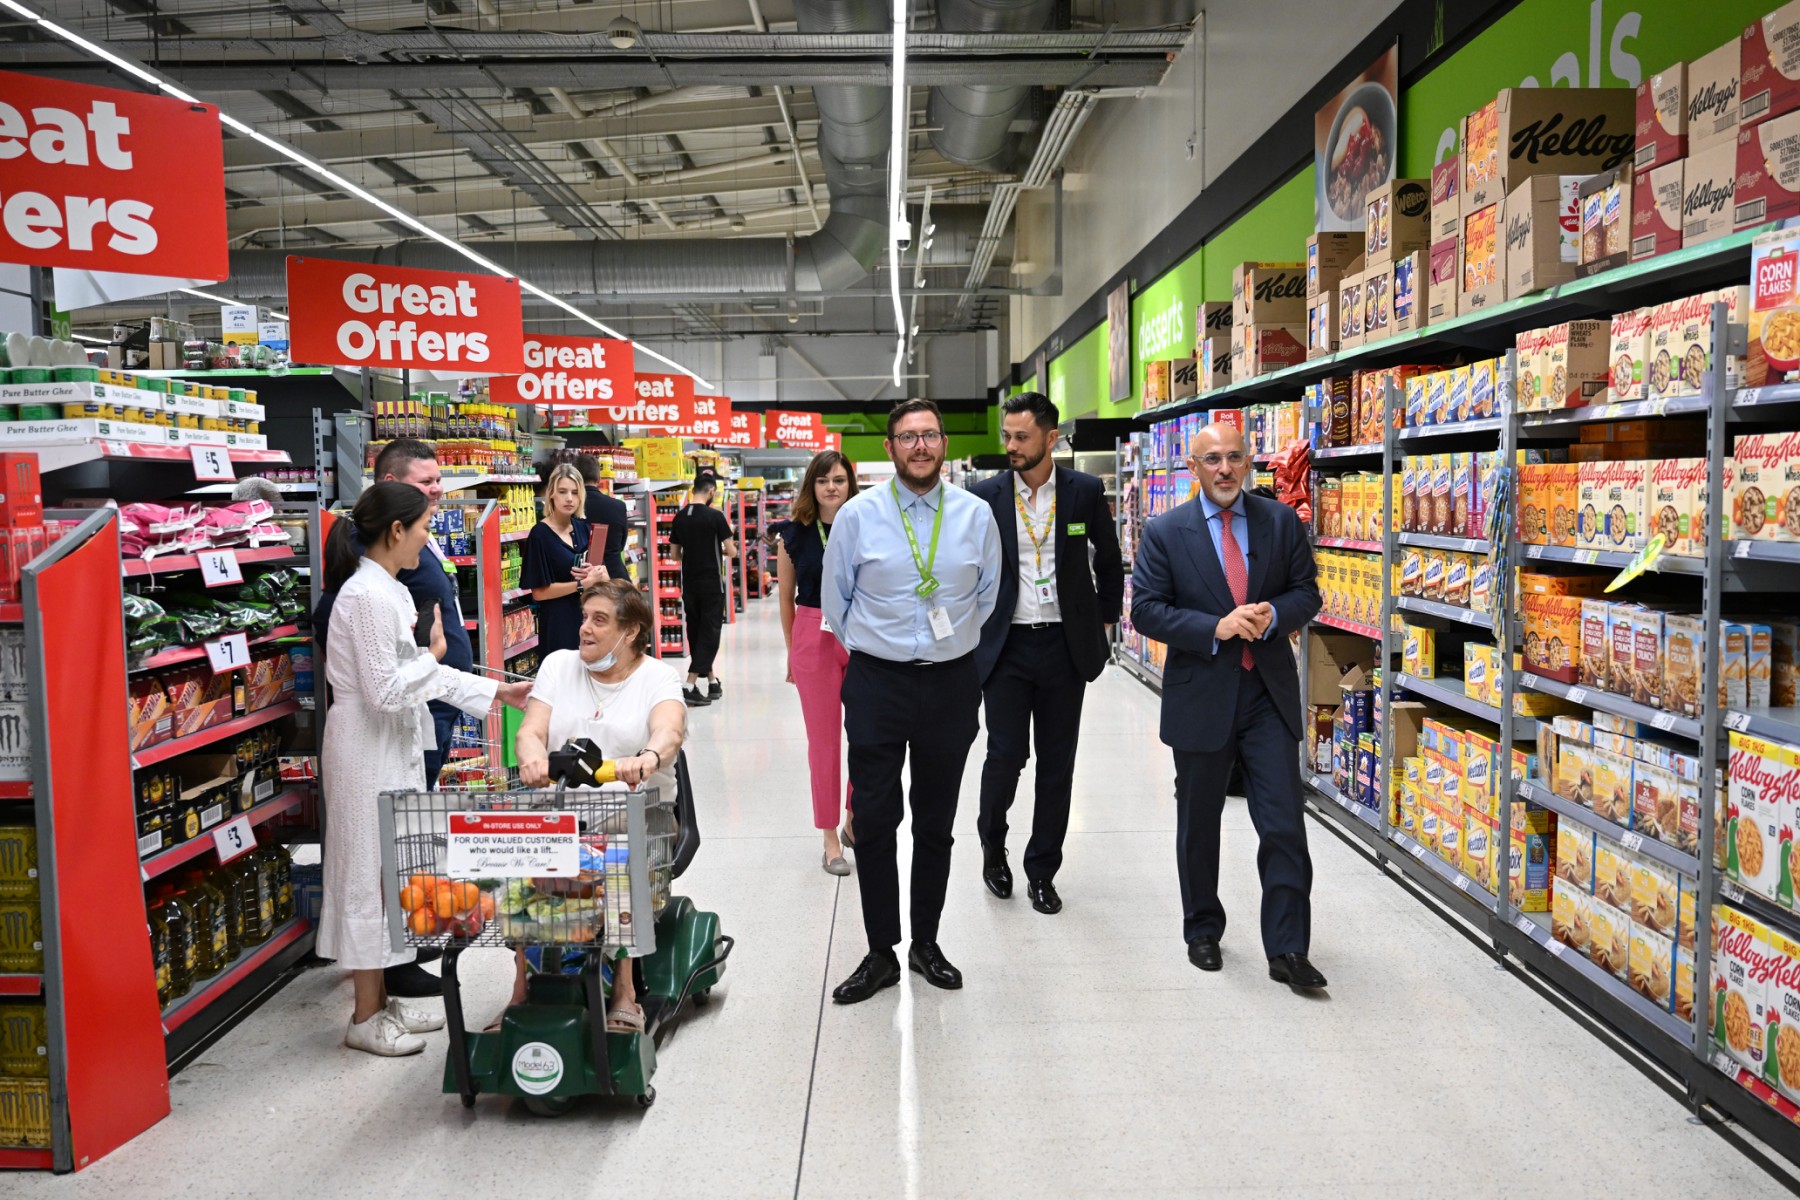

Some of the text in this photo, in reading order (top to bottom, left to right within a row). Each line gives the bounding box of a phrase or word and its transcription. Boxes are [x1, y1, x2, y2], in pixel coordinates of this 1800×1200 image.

[1688, 78, 1739, 121] Kellogg's
[1684, 177, 1736, 216] Kellogg's
[0, 191, 158, 255] ers
[1760, 261, 1793, 283] CORN
[342, 273, 477, 317] Great
[1759, 279, 1791, 296] FLAKES
[53, 321, 70, 338] 30
[1138, 294, 1183, 361] desserts
[337, 320, 490, 362] Offers
[523, 340, 606, 369] Great
[2, 387, 73, 397] Pure Butter Ghee
[517, 372, 613, 400] Offers
[608, 400, 680, 421] Offers
[779, 413, 811, 426] Great
[7, 424, 78, 435] Pure Butter Ghee
[776, 427, 813, 440] Offers
[205, 451, 220, 474] £5
[212, 556, 229, 578] £4
[220, 641, 233, 664] £7
[1739, 737, 1765, 753] BIG 1KG
[1467, 760, 1489, 780] Weetabix
[1741, 786, 1755, 799] CORN
[1741, 798, 1755, 811] FLAKES
[228, 826, 242, 848] £3
[1467, 833, 1488, 852] Weetabix
[490, 846, 514, 854] would
[477, 856, 551, 868] Because We Care!
[1729, 912, 1755, 933] BIG 1KG
[1784, 941, 1796, 955] BIG
[1730, 961, 1744, 977] CORN
[1729, 972, 1744, 987] FLAKES
[1747, 1028, 1762, 1041] FREE
[543, 1061, 555, 1071] 63
